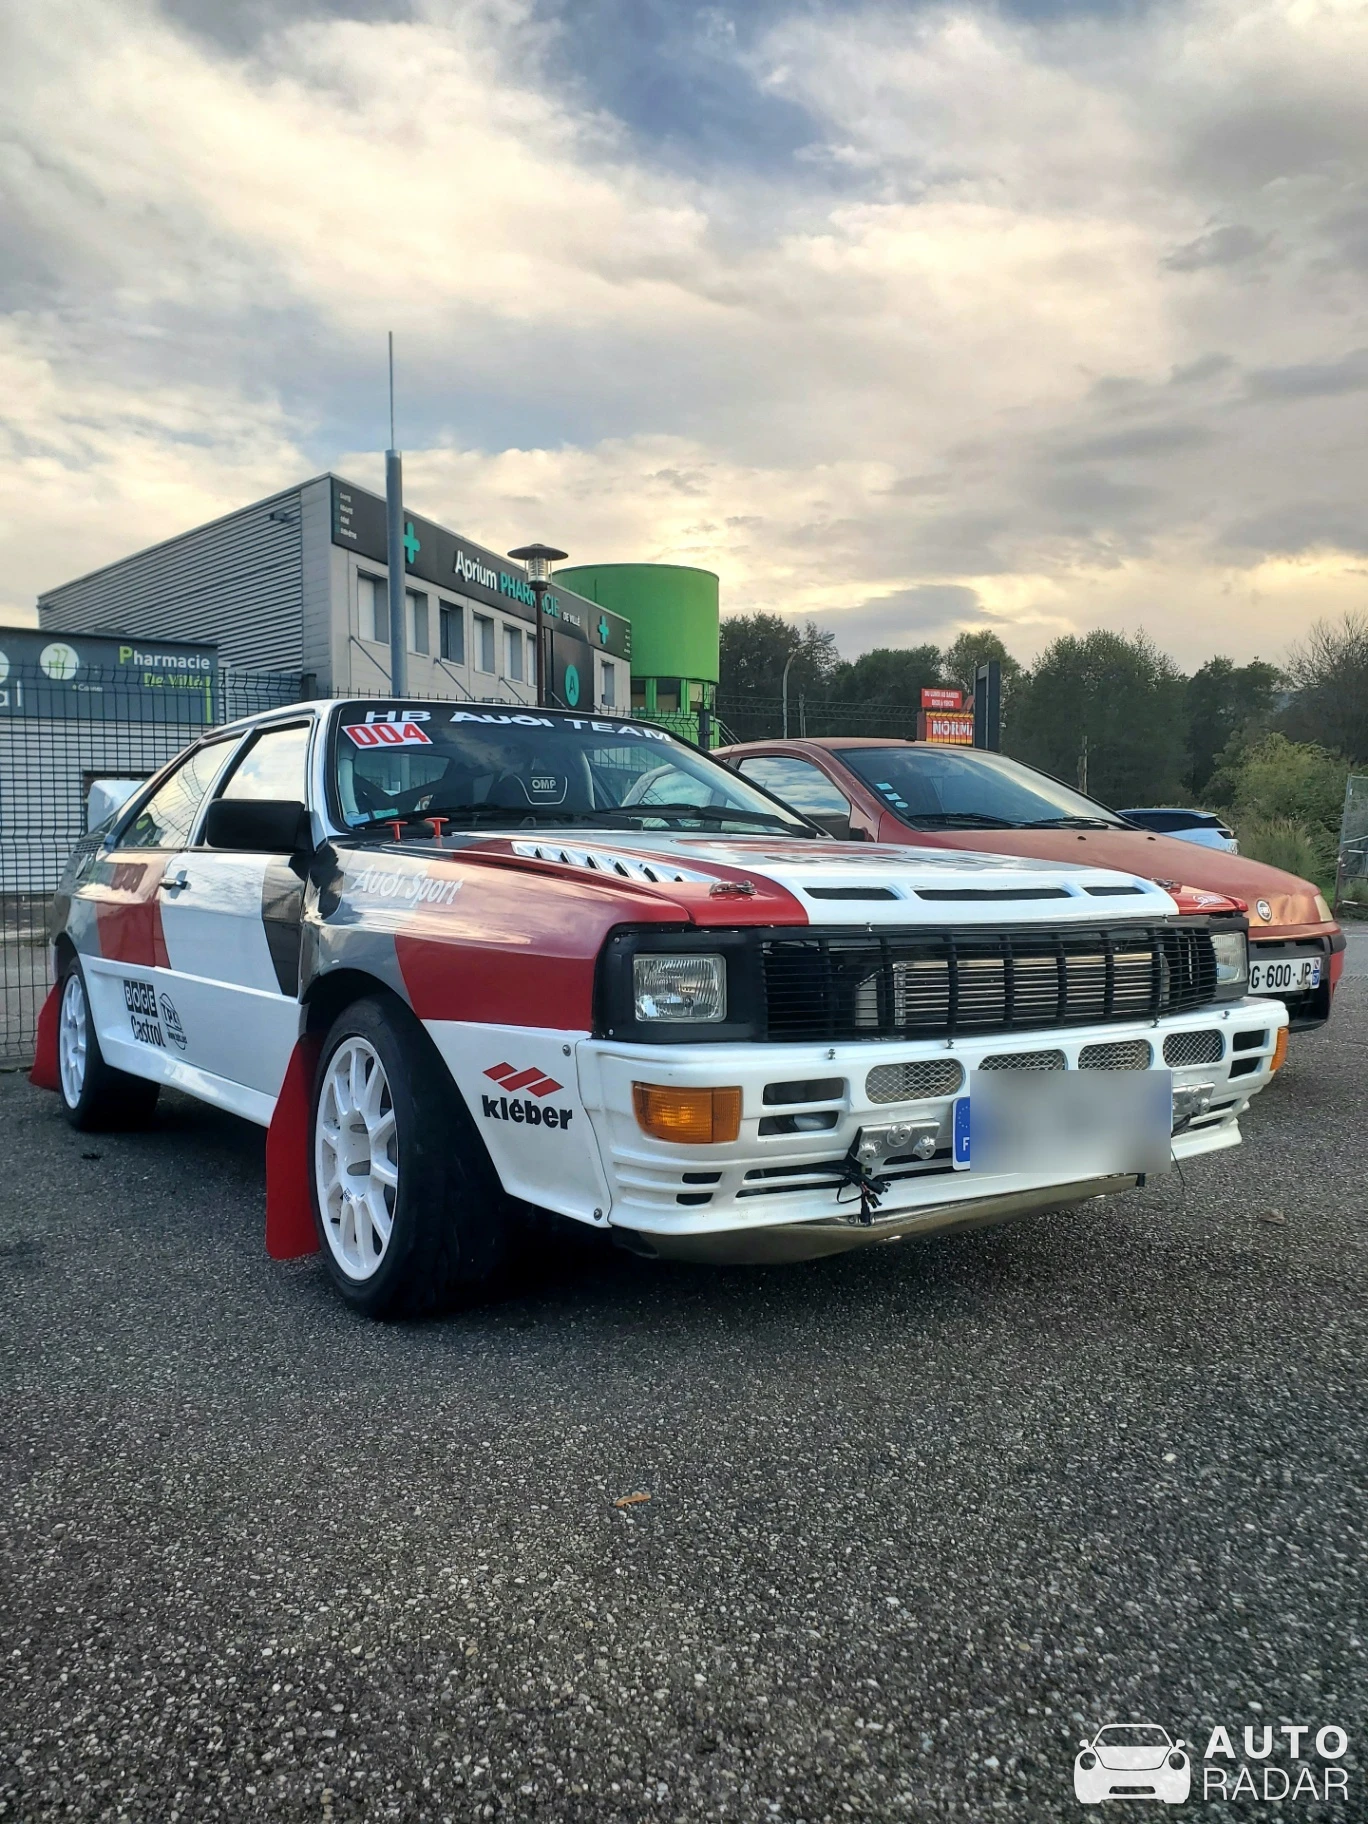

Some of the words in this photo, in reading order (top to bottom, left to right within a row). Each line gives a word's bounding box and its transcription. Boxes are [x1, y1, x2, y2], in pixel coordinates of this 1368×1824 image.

[454, 550, 497, 591] Aprium
[119, 646, 210, 669] Pharmacie
[346, 723, 430, 746] 004
[365, 710, 431, 723] HB
[564, 718, 672, 743] TEAM
[531, 779, 557, 790] OMP
[405, 869, 465, 908] Sport
[124, 985, 157, 1013] BOGE
[131, 1015, 166, 1047] Castrol
[481, 1094, 573, 1130] kléber
[962, 1136, 970, 1152] F
